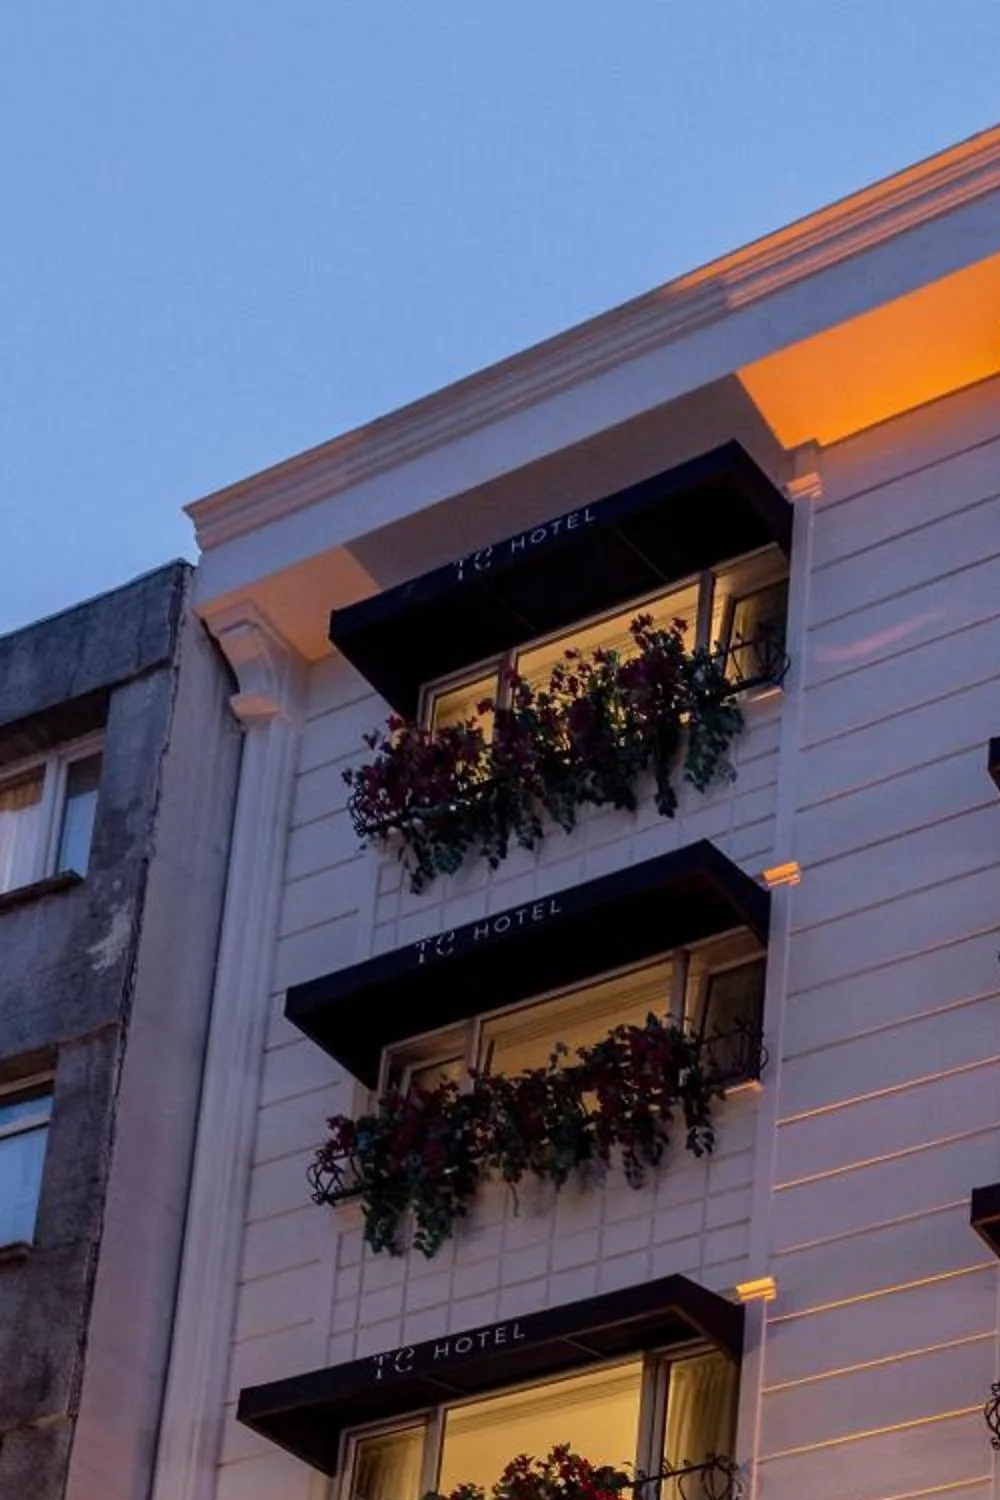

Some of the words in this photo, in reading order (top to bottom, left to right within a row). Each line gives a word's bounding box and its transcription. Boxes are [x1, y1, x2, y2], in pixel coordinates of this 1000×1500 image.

[511, 508, 595, 553] HOTEL
[473, 899, 562, 940] HOTEL
[433, 1322, 525, 1361] HOTEL
